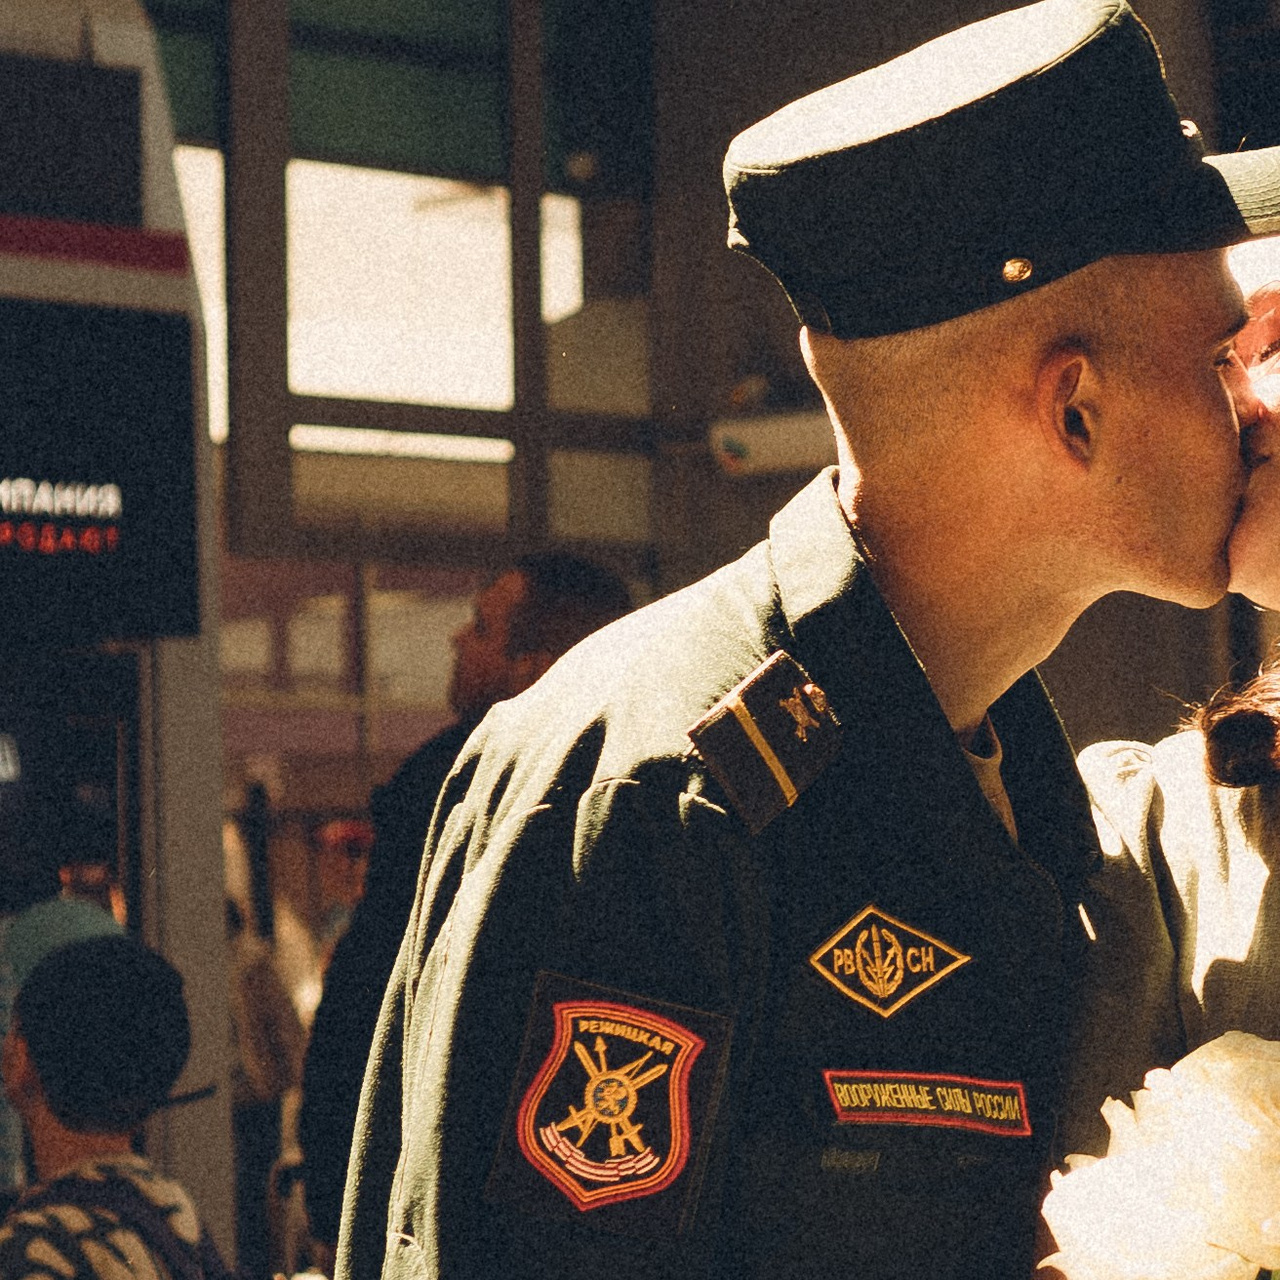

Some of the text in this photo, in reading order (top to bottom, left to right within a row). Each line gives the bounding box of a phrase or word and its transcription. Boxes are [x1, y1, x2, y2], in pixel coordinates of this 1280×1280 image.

[578, 1019, 675, 1056] РЕЖИЦКАЯ
[936, 1087, 973, 1113] СИЛЫ
[972, 1091, 1022, 1120] РОССИИ
